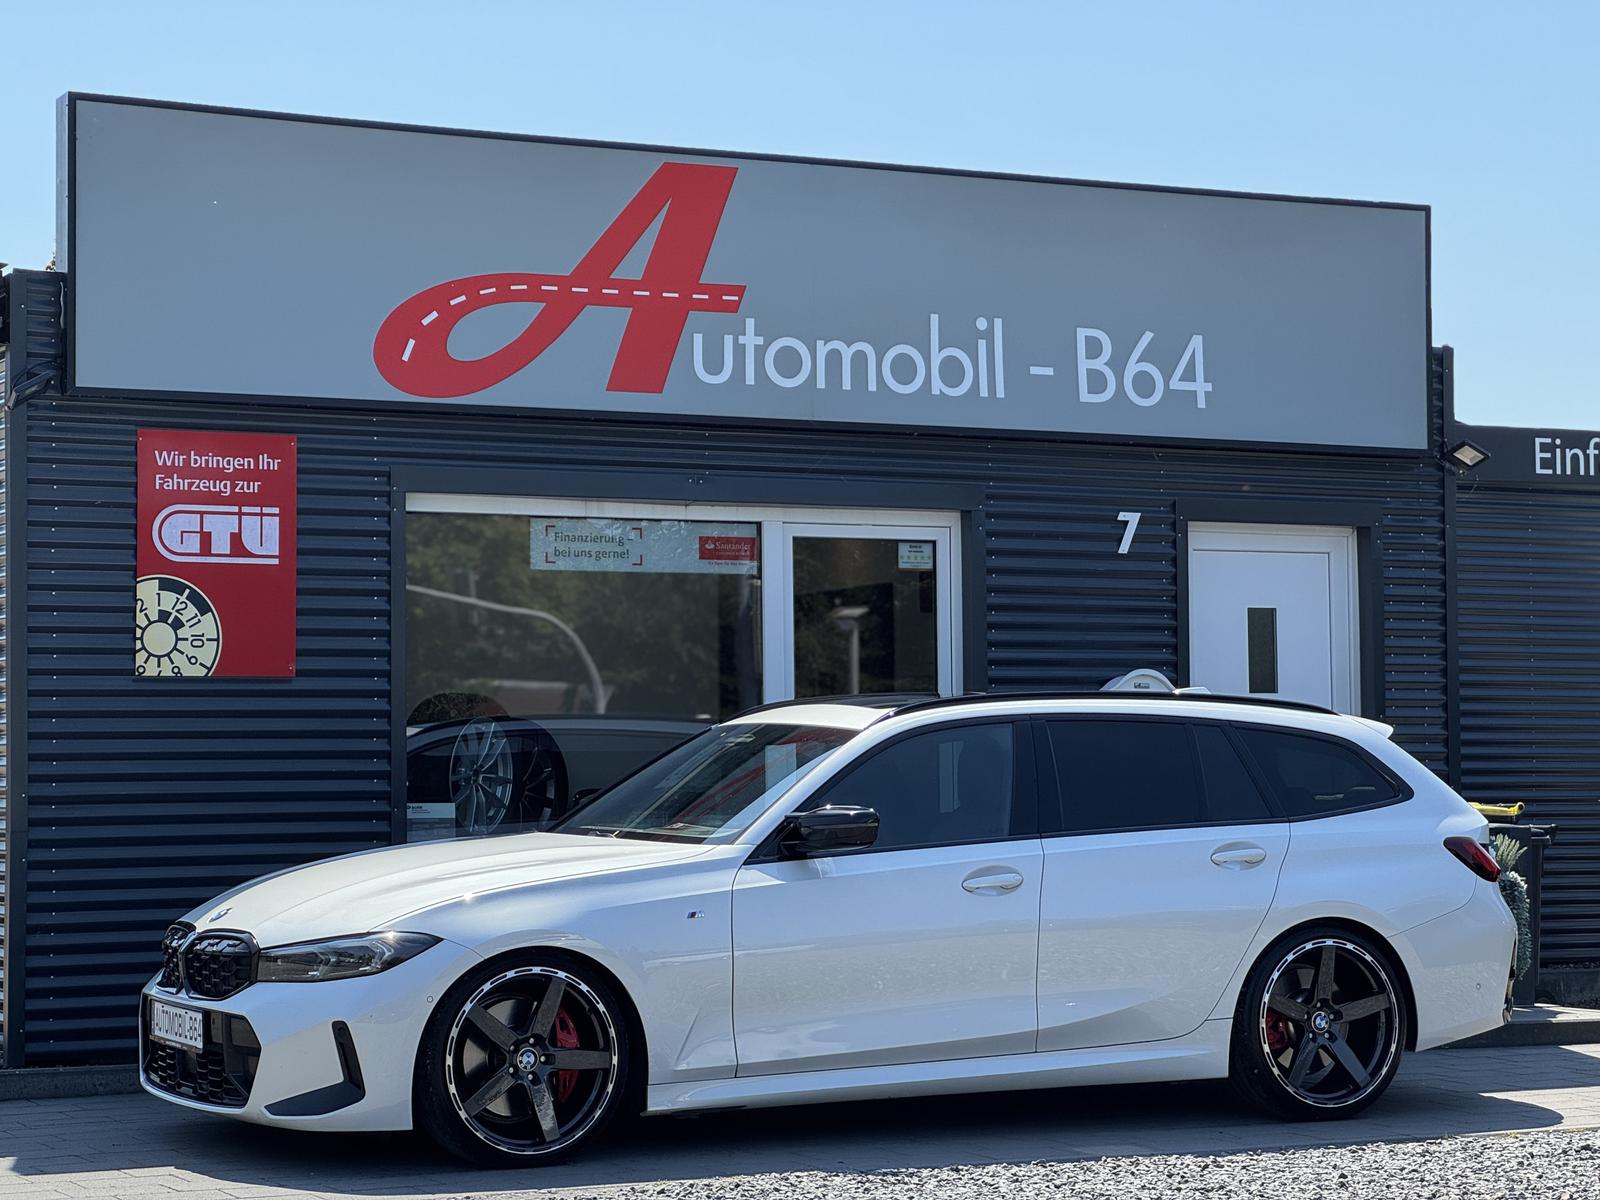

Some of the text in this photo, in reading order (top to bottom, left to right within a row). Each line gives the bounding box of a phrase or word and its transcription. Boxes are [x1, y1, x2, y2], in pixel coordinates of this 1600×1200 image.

[373, 161, 1005, 399] Automobil
[1076, 326, 1213, 409] B64
[154, 450, 281, 472] Wir bringen Ihr
[155, 474, 261, 496] Fahrzeug zur
[152, 504, 280, 565] GTÜ
[554, 532, 624, 546] Finanzierung
[1117, 511, 1141, 554] 7
[554, 547, 630, 561] bei uns gerne!
[172, 597, 188, 616] 12
[190, 632, 205, 648] 10
[154, 1006, 202, 1042] AUTOMOBIL-B64
